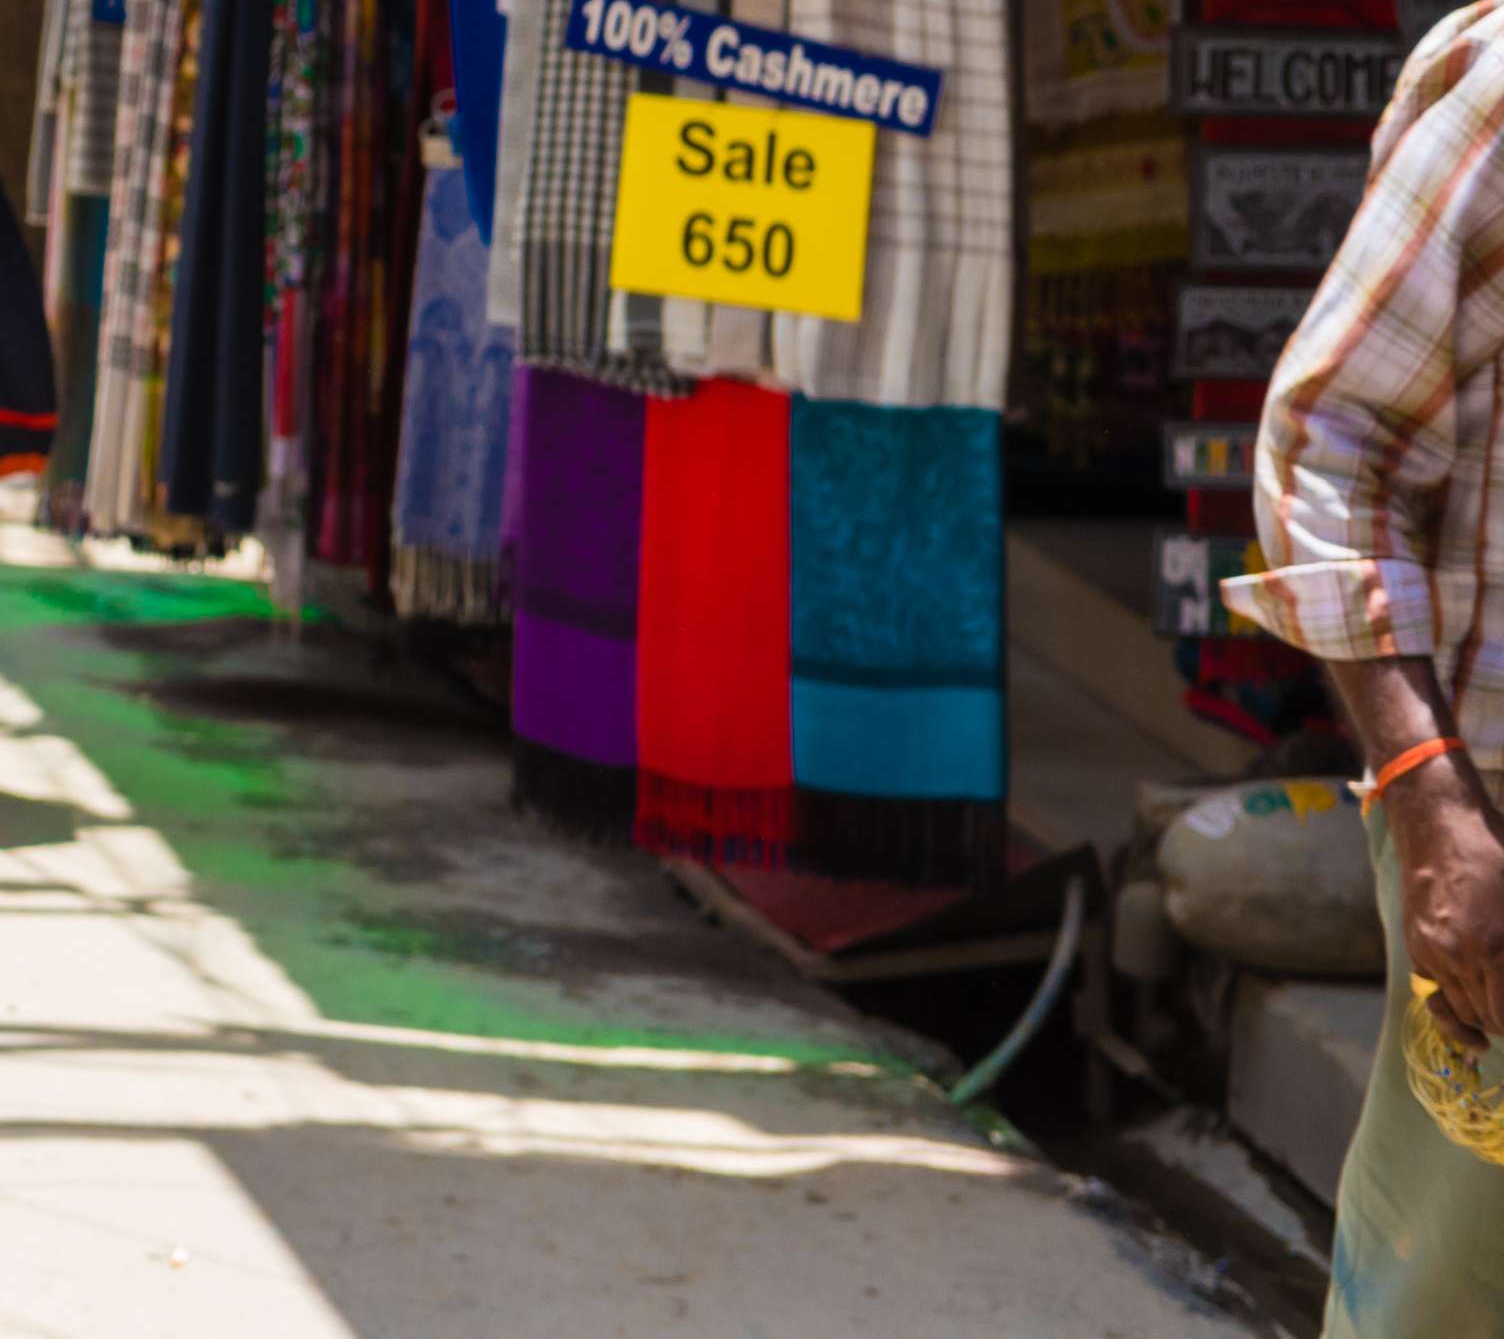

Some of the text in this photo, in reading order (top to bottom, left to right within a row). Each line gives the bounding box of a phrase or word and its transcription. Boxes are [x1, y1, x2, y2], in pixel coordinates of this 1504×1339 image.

[705, 24, 931, 127] Cashmere
[674, 120, 817, 191] Sale
[681, 211, 797, 280] 650
